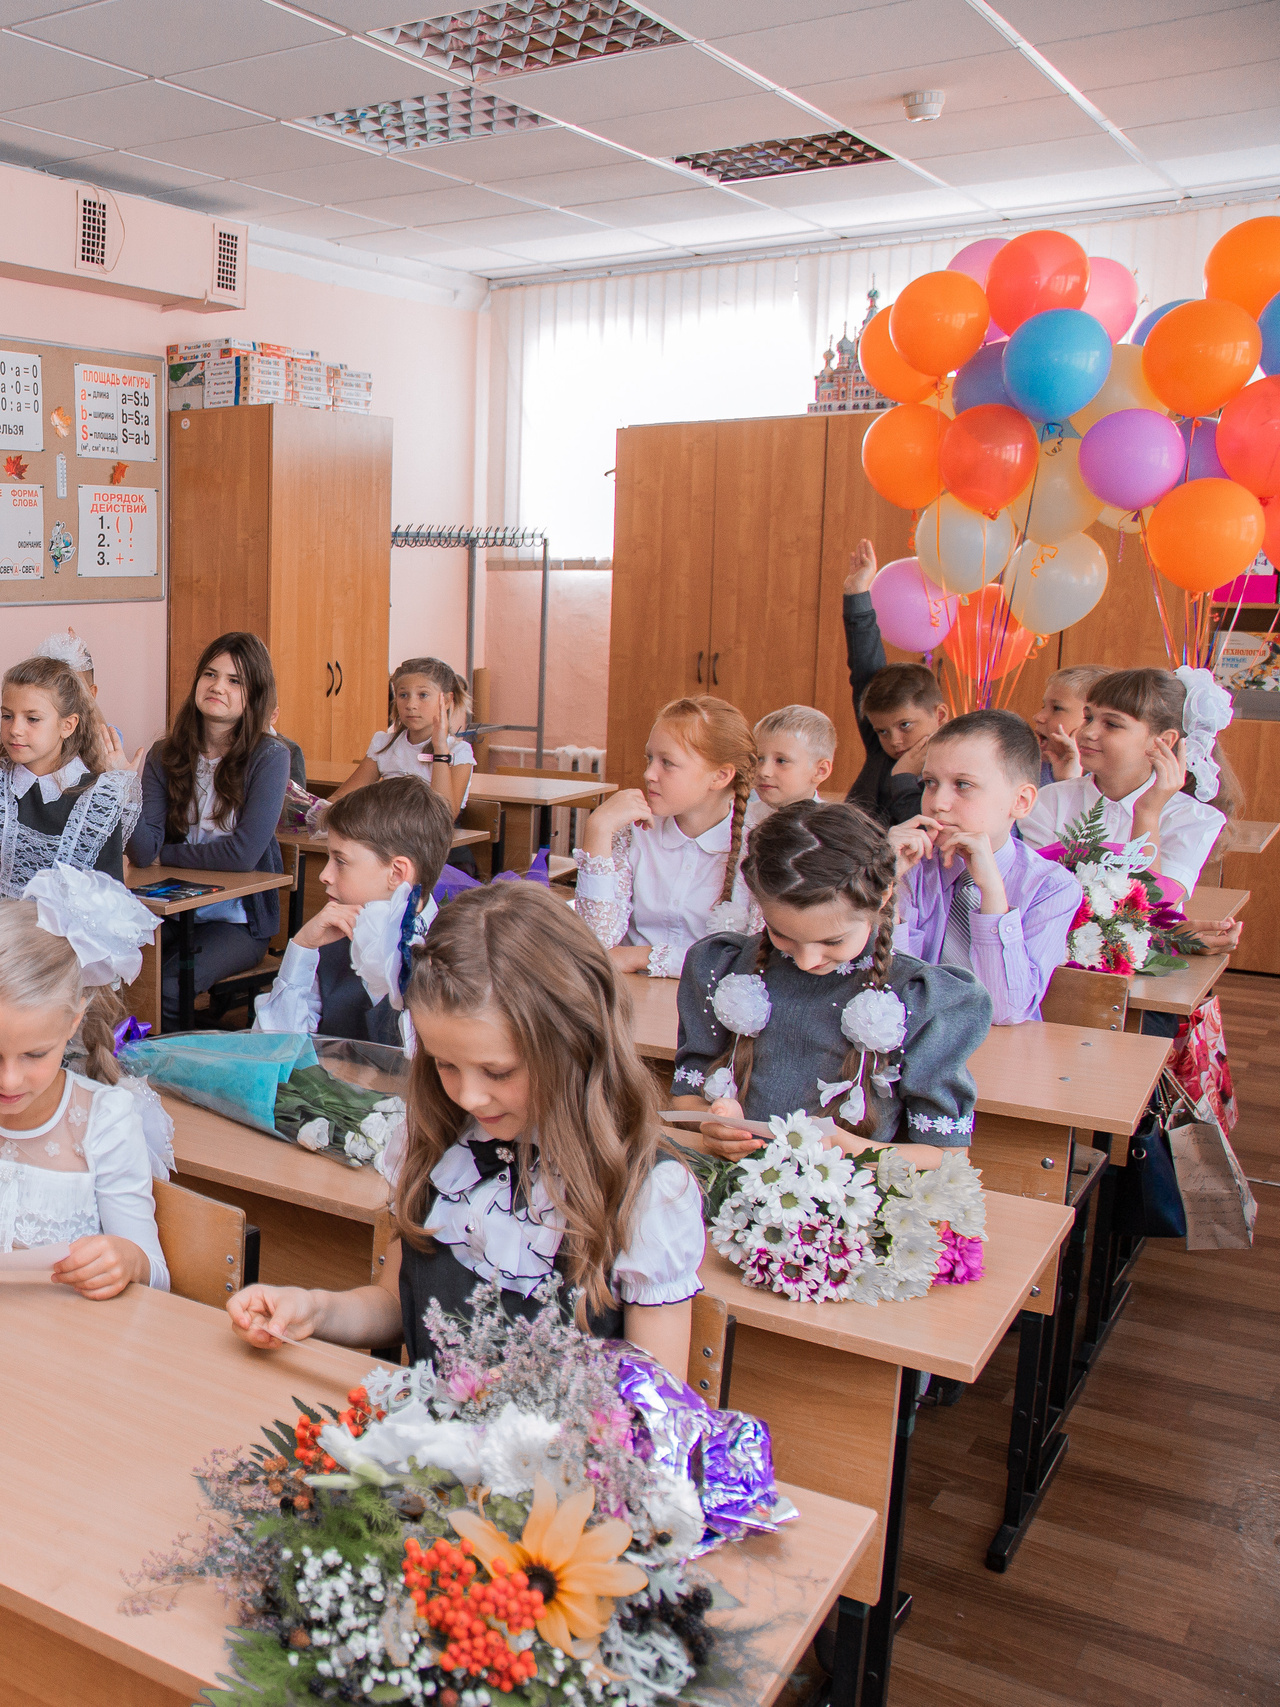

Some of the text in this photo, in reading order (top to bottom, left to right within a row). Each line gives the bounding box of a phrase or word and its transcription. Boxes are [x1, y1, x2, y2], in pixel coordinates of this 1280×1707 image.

[179, 353, 199, 362] Puzzle
[83, 370, 150, 389] ПЛОЩАДЬ ФИГУРЫ
[93, 390, 109, 399] длина
[81, 405, 87, 420] b
[93, 411, 114, 421] ширина
[82, 425, 88, 440] S
[94, 432, 118, 441] площадь
[11, 489, 38, 497] ФОРМА
[94, 493, 144, 504] ПОРЯДОК
[12, 499, 38, 507] СЛОВА
[90, 502, 147, 514] ДЕЙСТВИЙ
